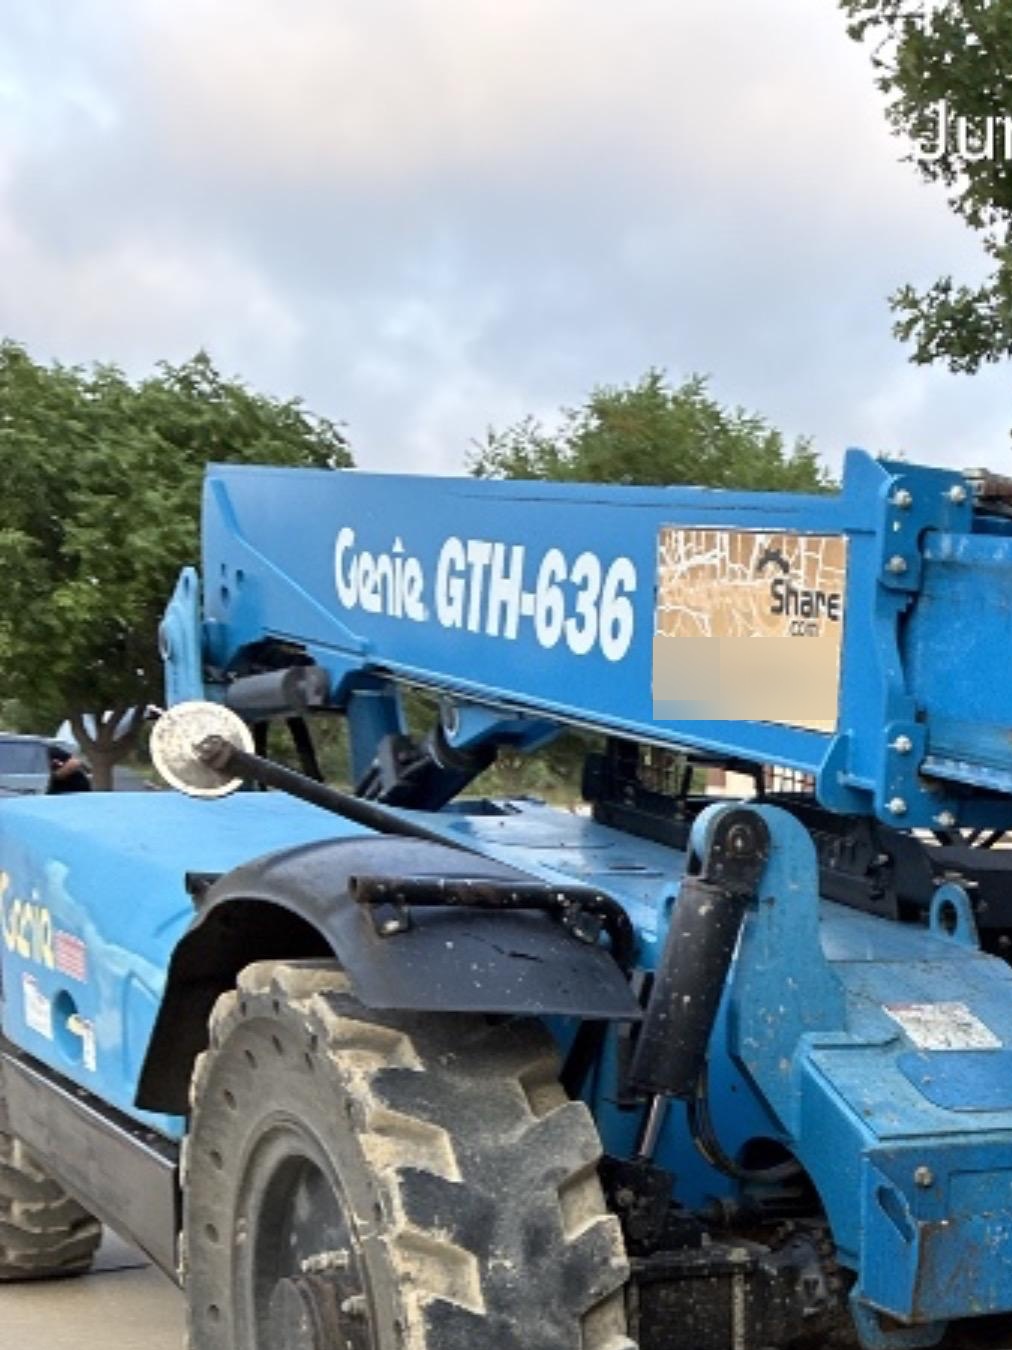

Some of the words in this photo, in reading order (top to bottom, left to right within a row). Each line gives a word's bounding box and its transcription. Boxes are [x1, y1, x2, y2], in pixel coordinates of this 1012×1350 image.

[334, 527, 429, 621] Genie
[435, 536, 637, 661] GTH-636
[770, 578, 840, 621] Share
